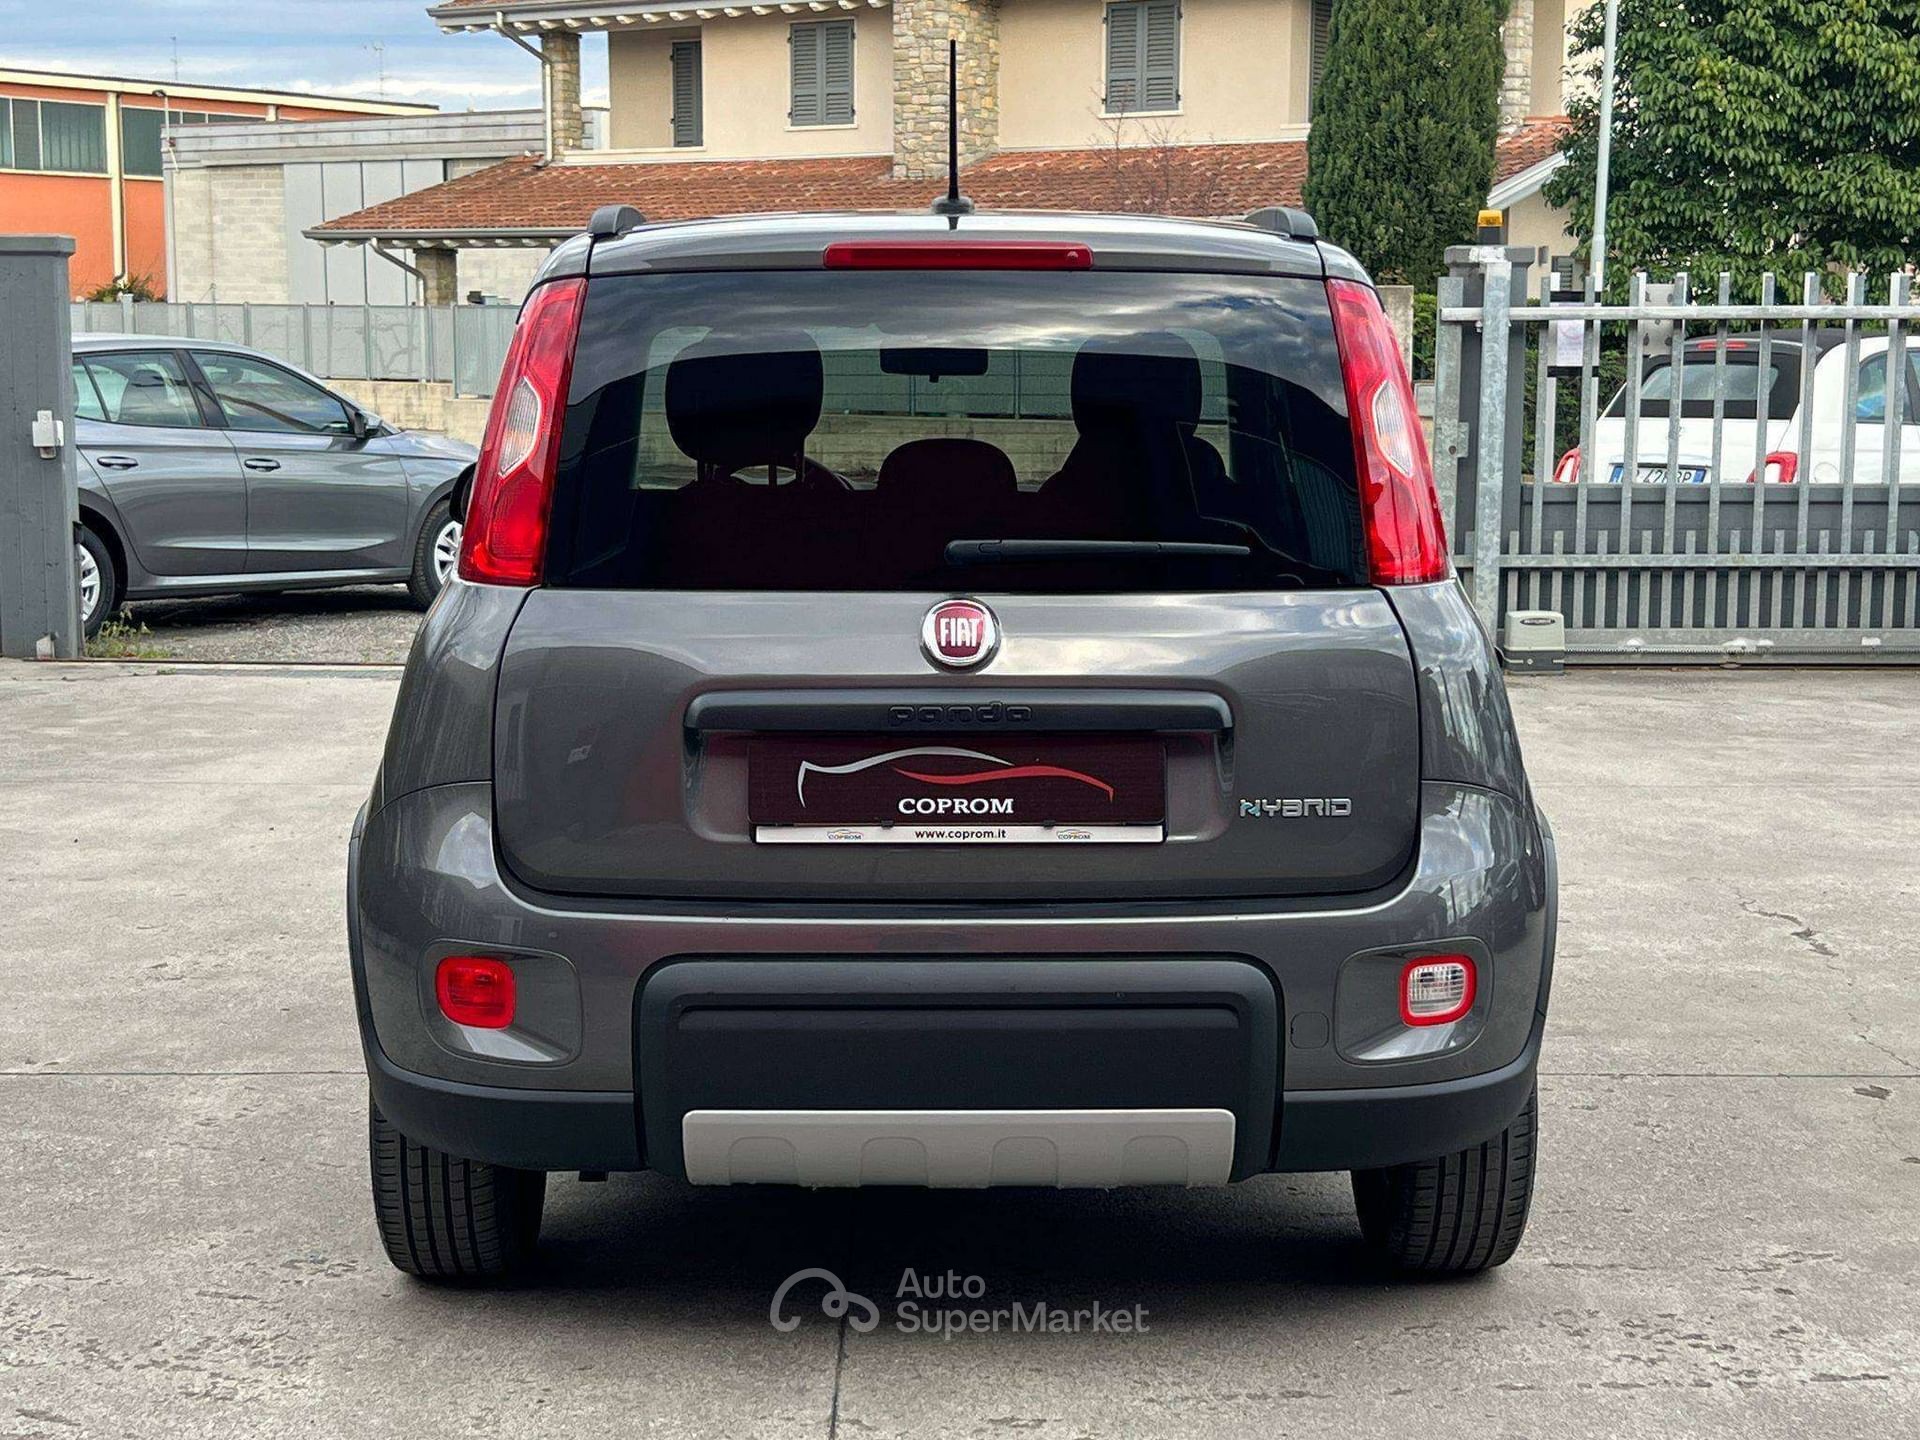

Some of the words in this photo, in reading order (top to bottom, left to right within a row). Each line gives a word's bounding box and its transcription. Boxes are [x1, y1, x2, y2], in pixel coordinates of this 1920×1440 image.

[940, 617, 980, 647] FIAT
[889, 702, 1032, 727] panda
[898, 798, 1014, 814] COPROM
[1240, 798, 1352, 817] HYBRID
[915, 828, 1007, 840] www.coprom.it
